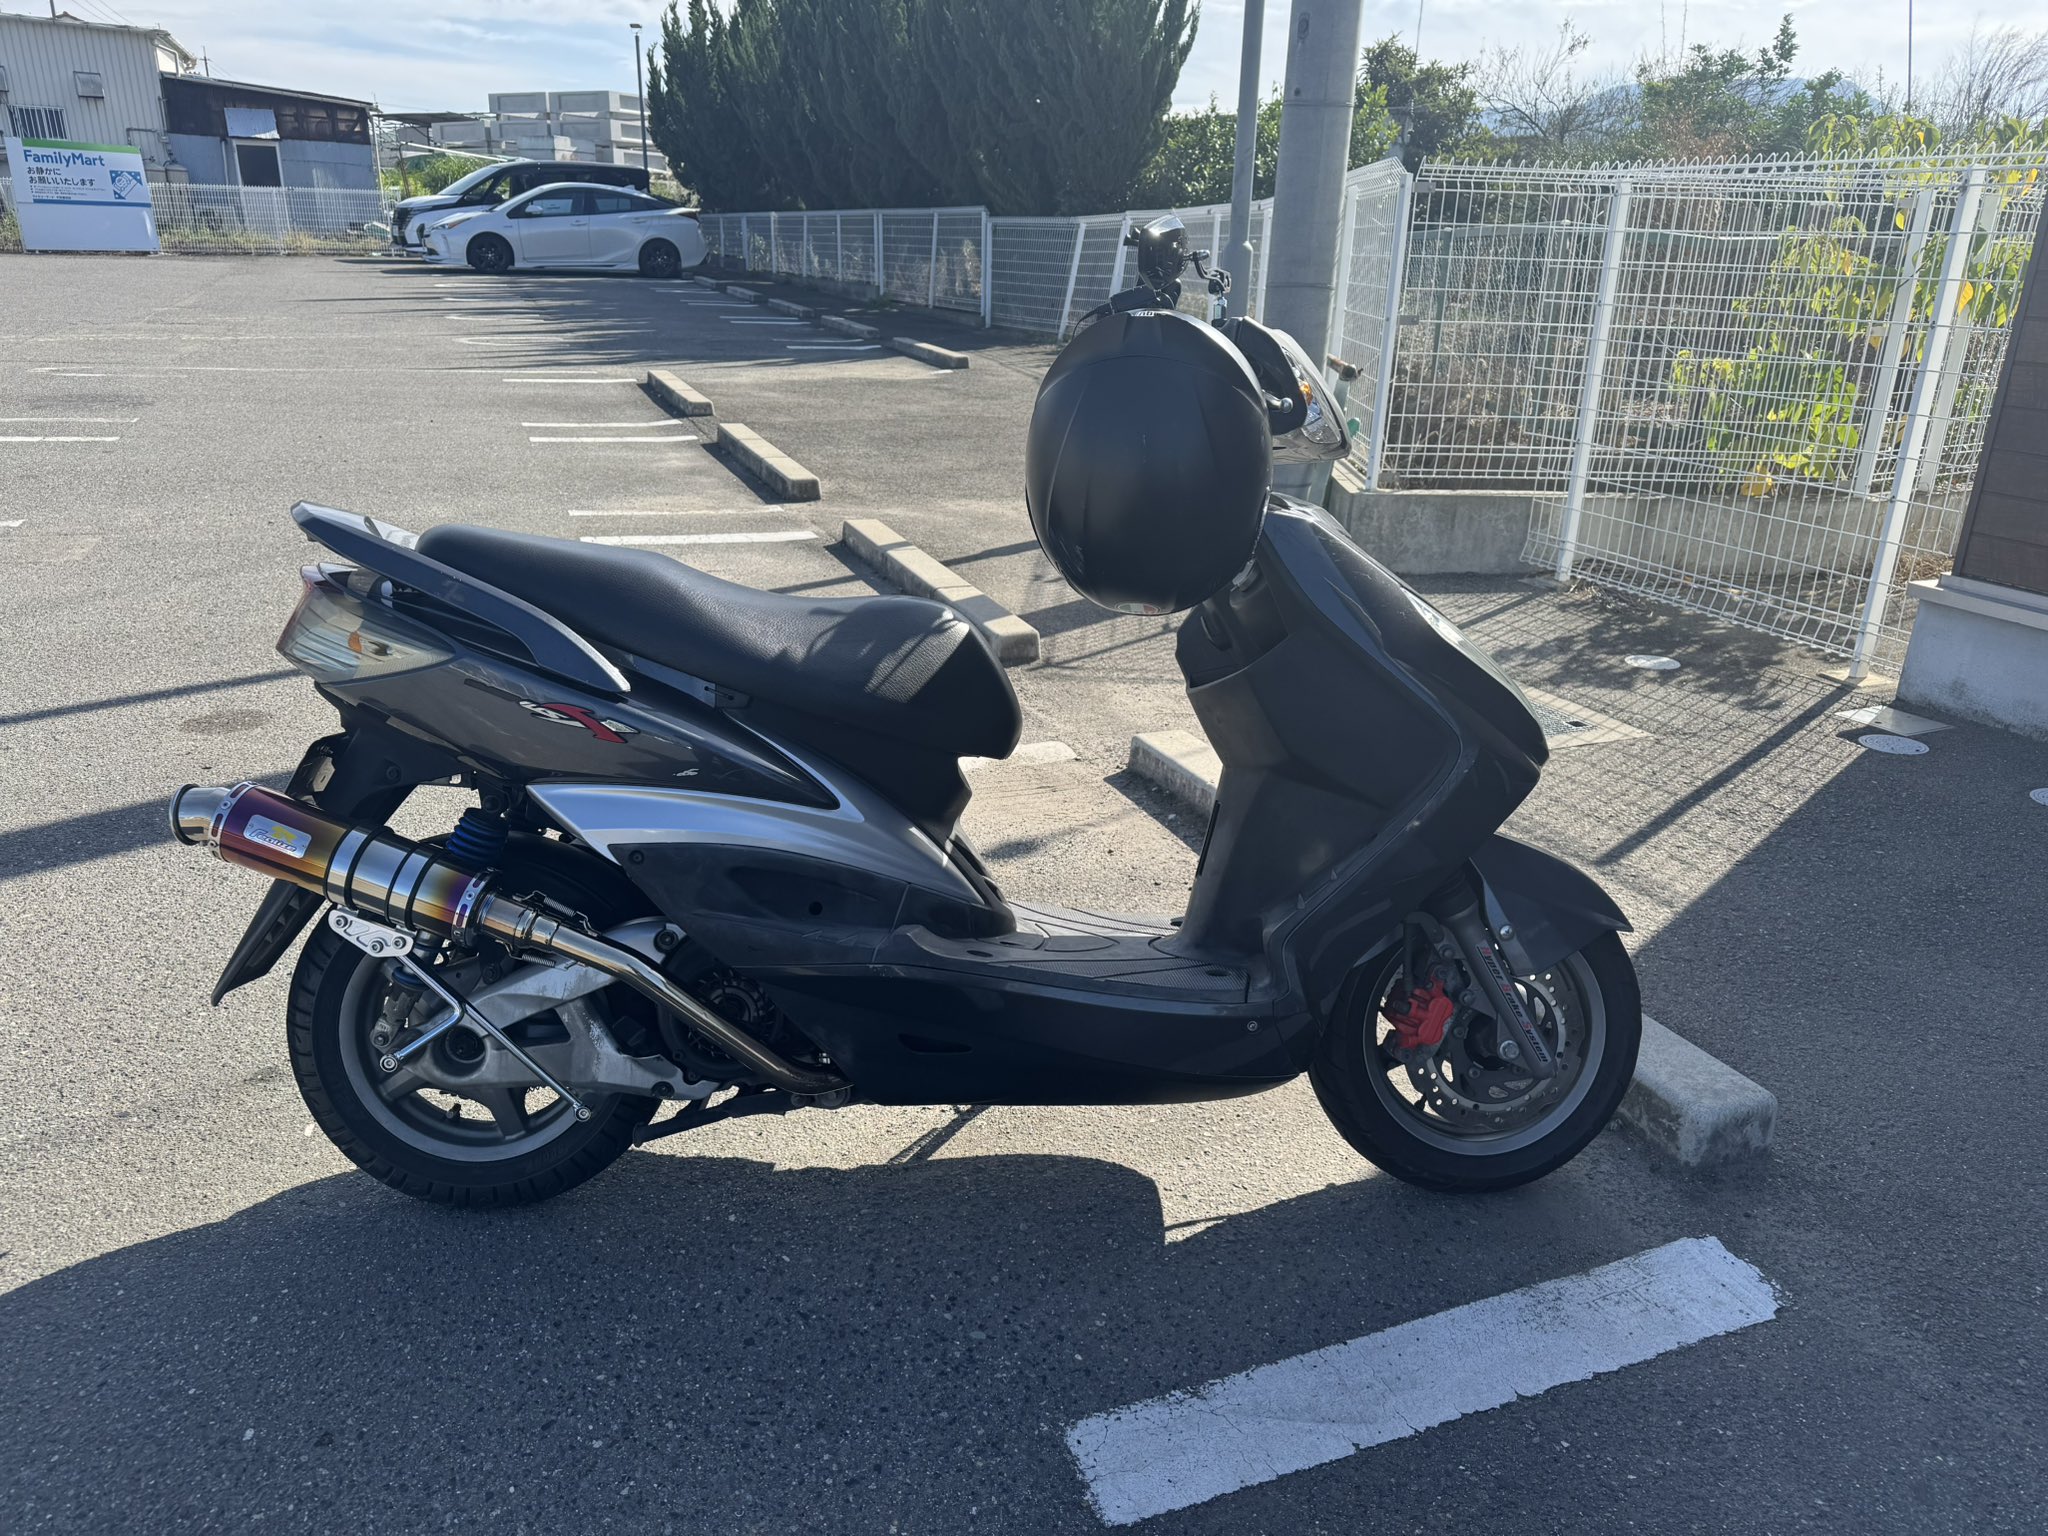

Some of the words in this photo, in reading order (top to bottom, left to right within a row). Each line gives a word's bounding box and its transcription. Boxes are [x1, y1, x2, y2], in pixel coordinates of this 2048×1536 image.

[23, 149, 105, 168] FamilyMart
[27, 166, 62, 176] お静かに
[29, 176, 95, 187] お願いいたします
[1481, 945, 1504, 981] Hyper
[1501, 983, 1523, 1018] Brake
[1521, 1022, 1549, 1064] System
